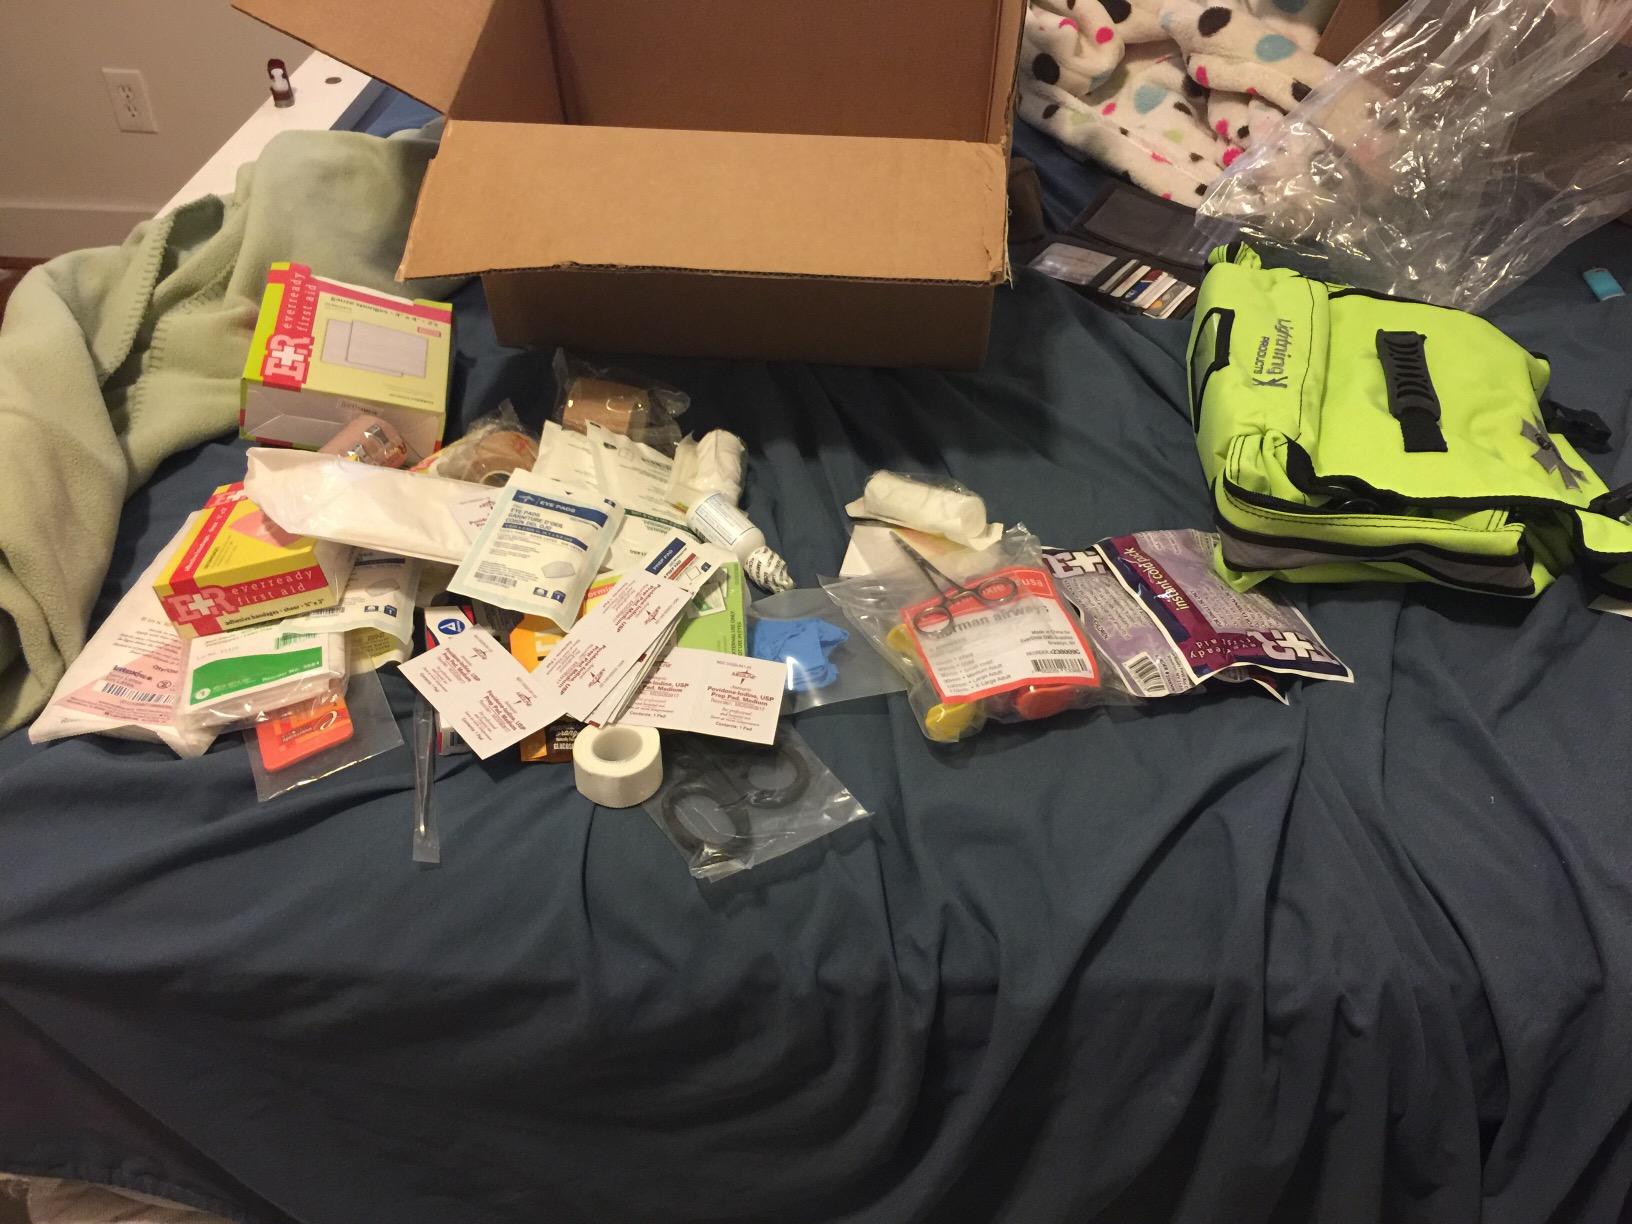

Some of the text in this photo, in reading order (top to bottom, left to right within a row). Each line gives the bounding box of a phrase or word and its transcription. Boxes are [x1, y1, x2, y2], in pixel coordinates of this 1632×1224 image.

[284, 272, 306, 330] everready
[297, 284, 316, 332] first aid
[1254, 336, 1270, 374] PRODUCTS
[1266, 319, 1294, 374] Lightning
[232, 570, 312, 596] everready
[1021, 578, 1043, 588] usa
[1140, 559, 1164, 581] cold
[238, 582, 306, 606] first aid
[1155, 576, 1189, 614] instant
[1194, 638, 1217, 647] aid
